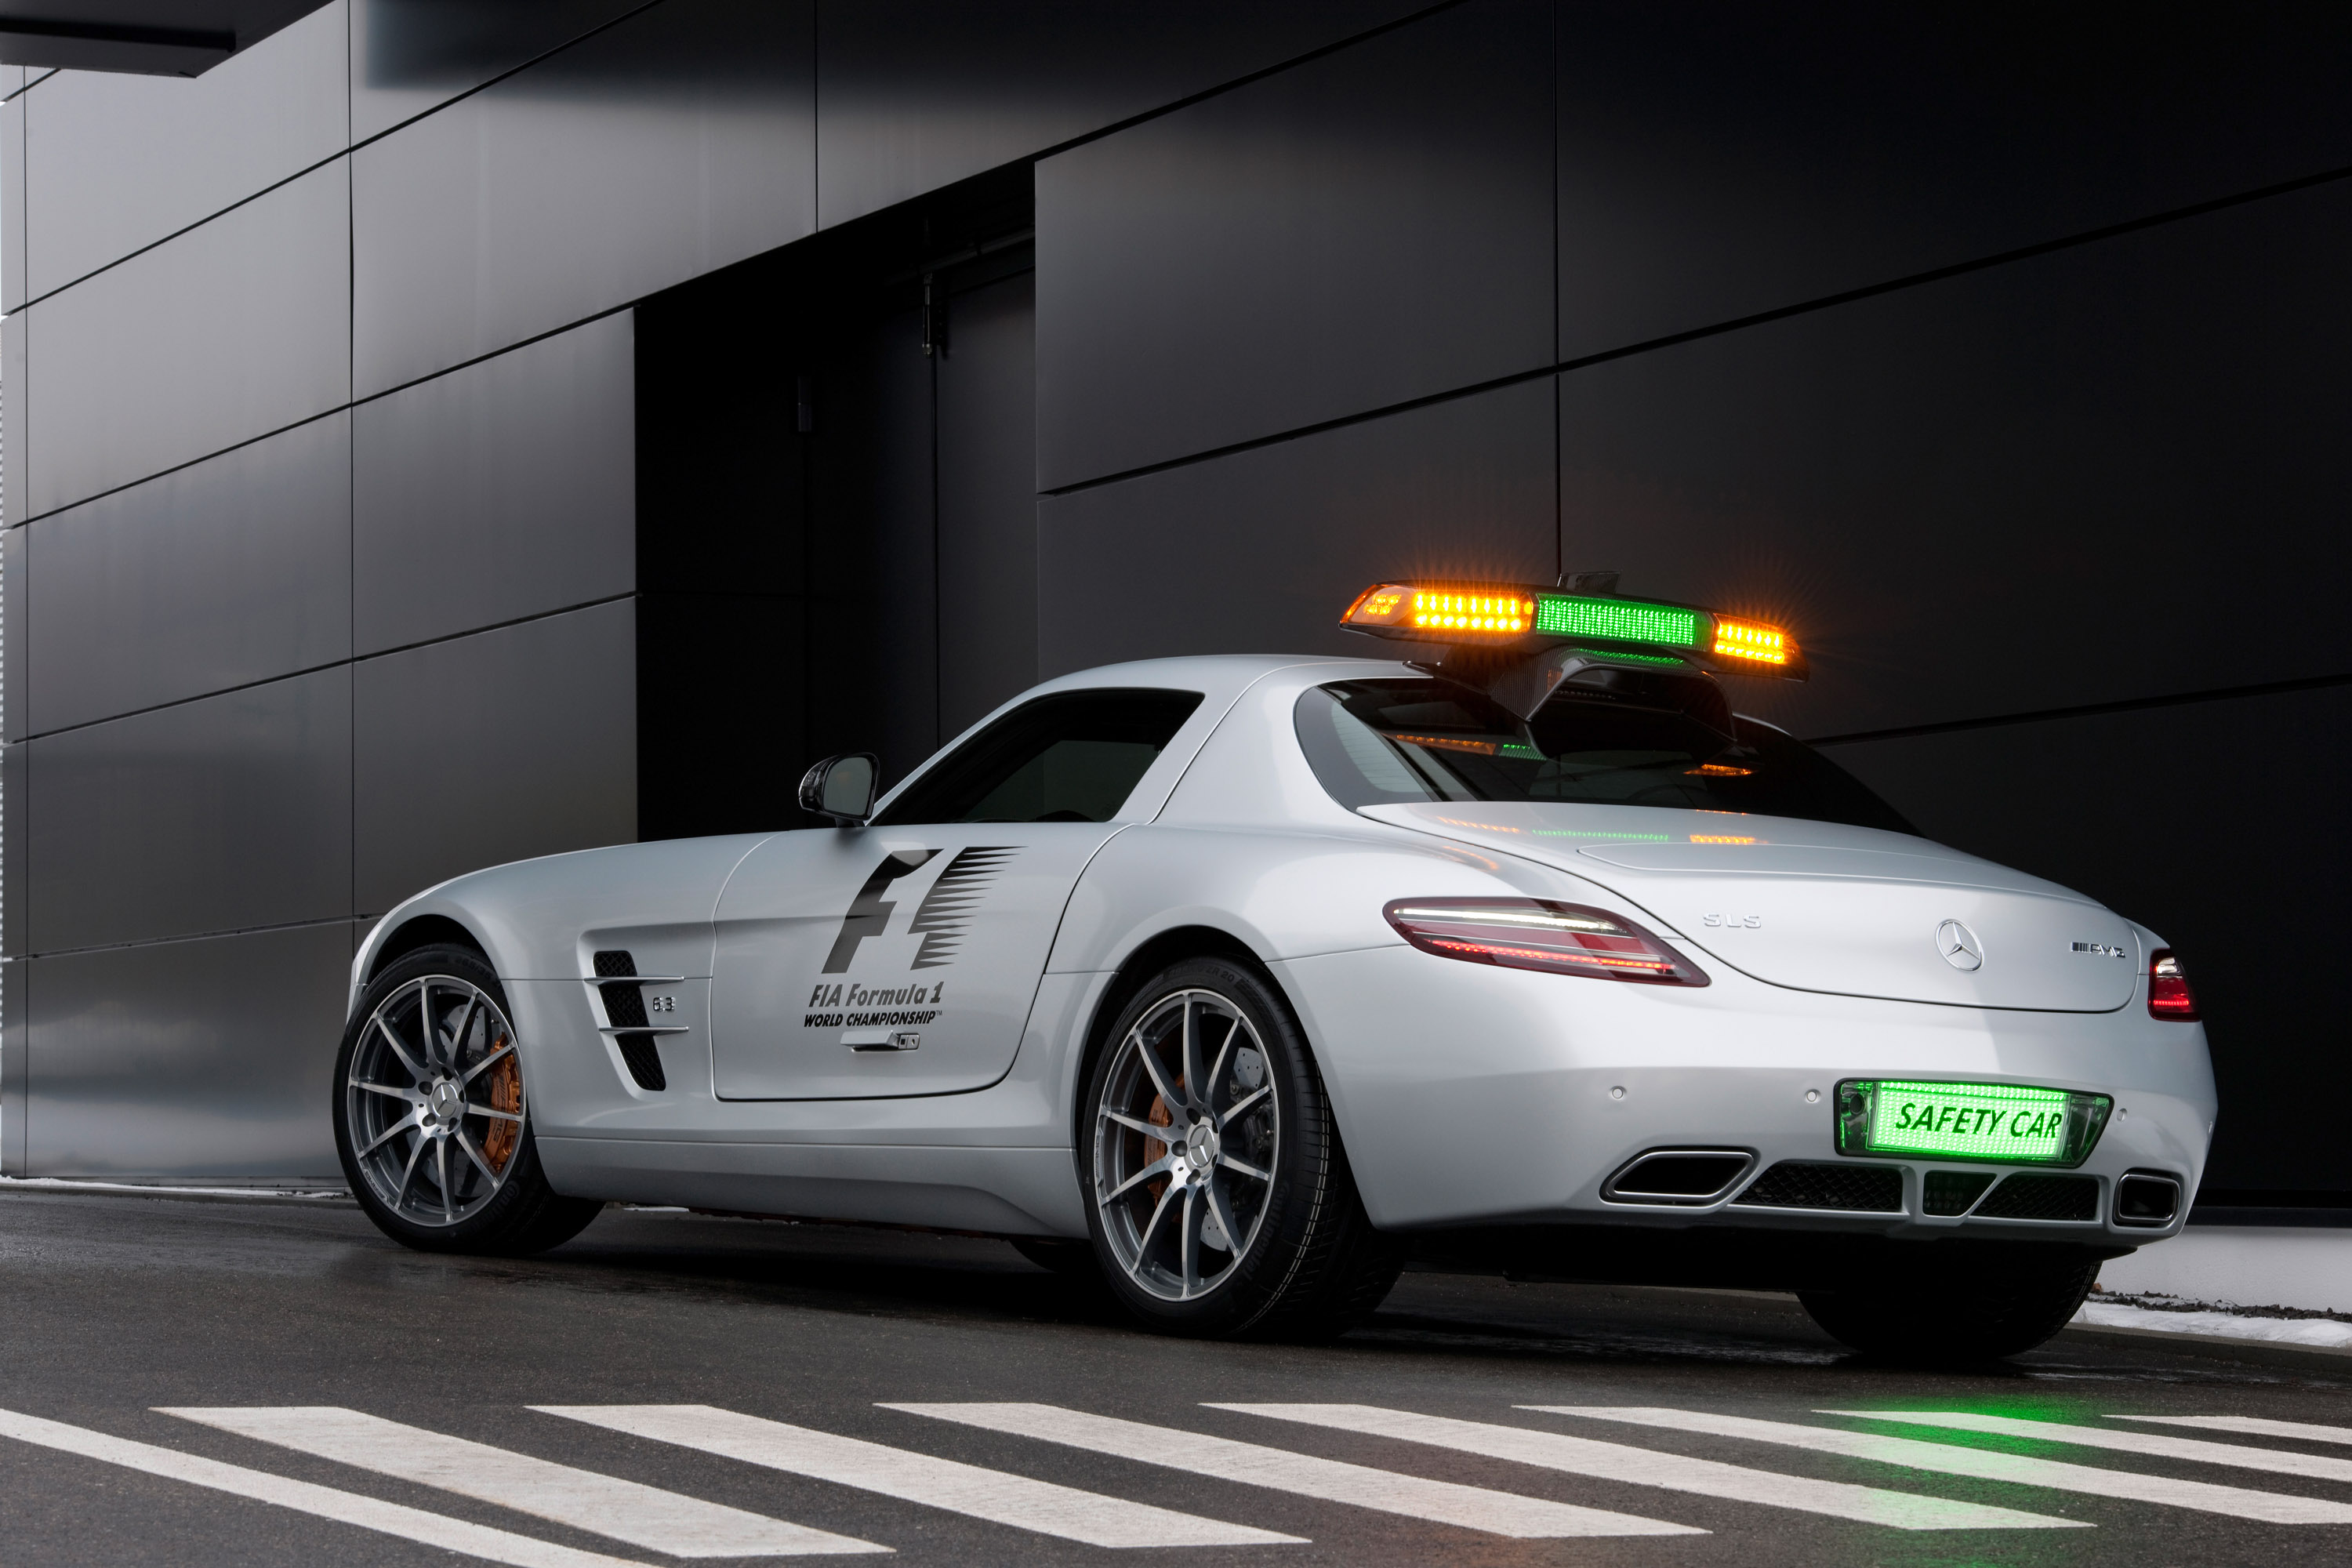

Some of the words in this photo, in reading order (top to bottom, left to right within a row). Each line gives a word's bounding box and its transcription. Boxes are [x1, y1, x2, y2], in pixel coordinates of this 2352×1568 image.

[1703, 913, 1762, 928] SLS
[808, 984, 843, 1007] FIA
[845, 983, 928, 1007] Formula
[930, 981, 944, 1004] 1
[804, 1014, 843, 1028] WORLD
[1896, 1103, 2007, 1135] SAFETY
[2010, 1110, 2063, 1138] CAR
